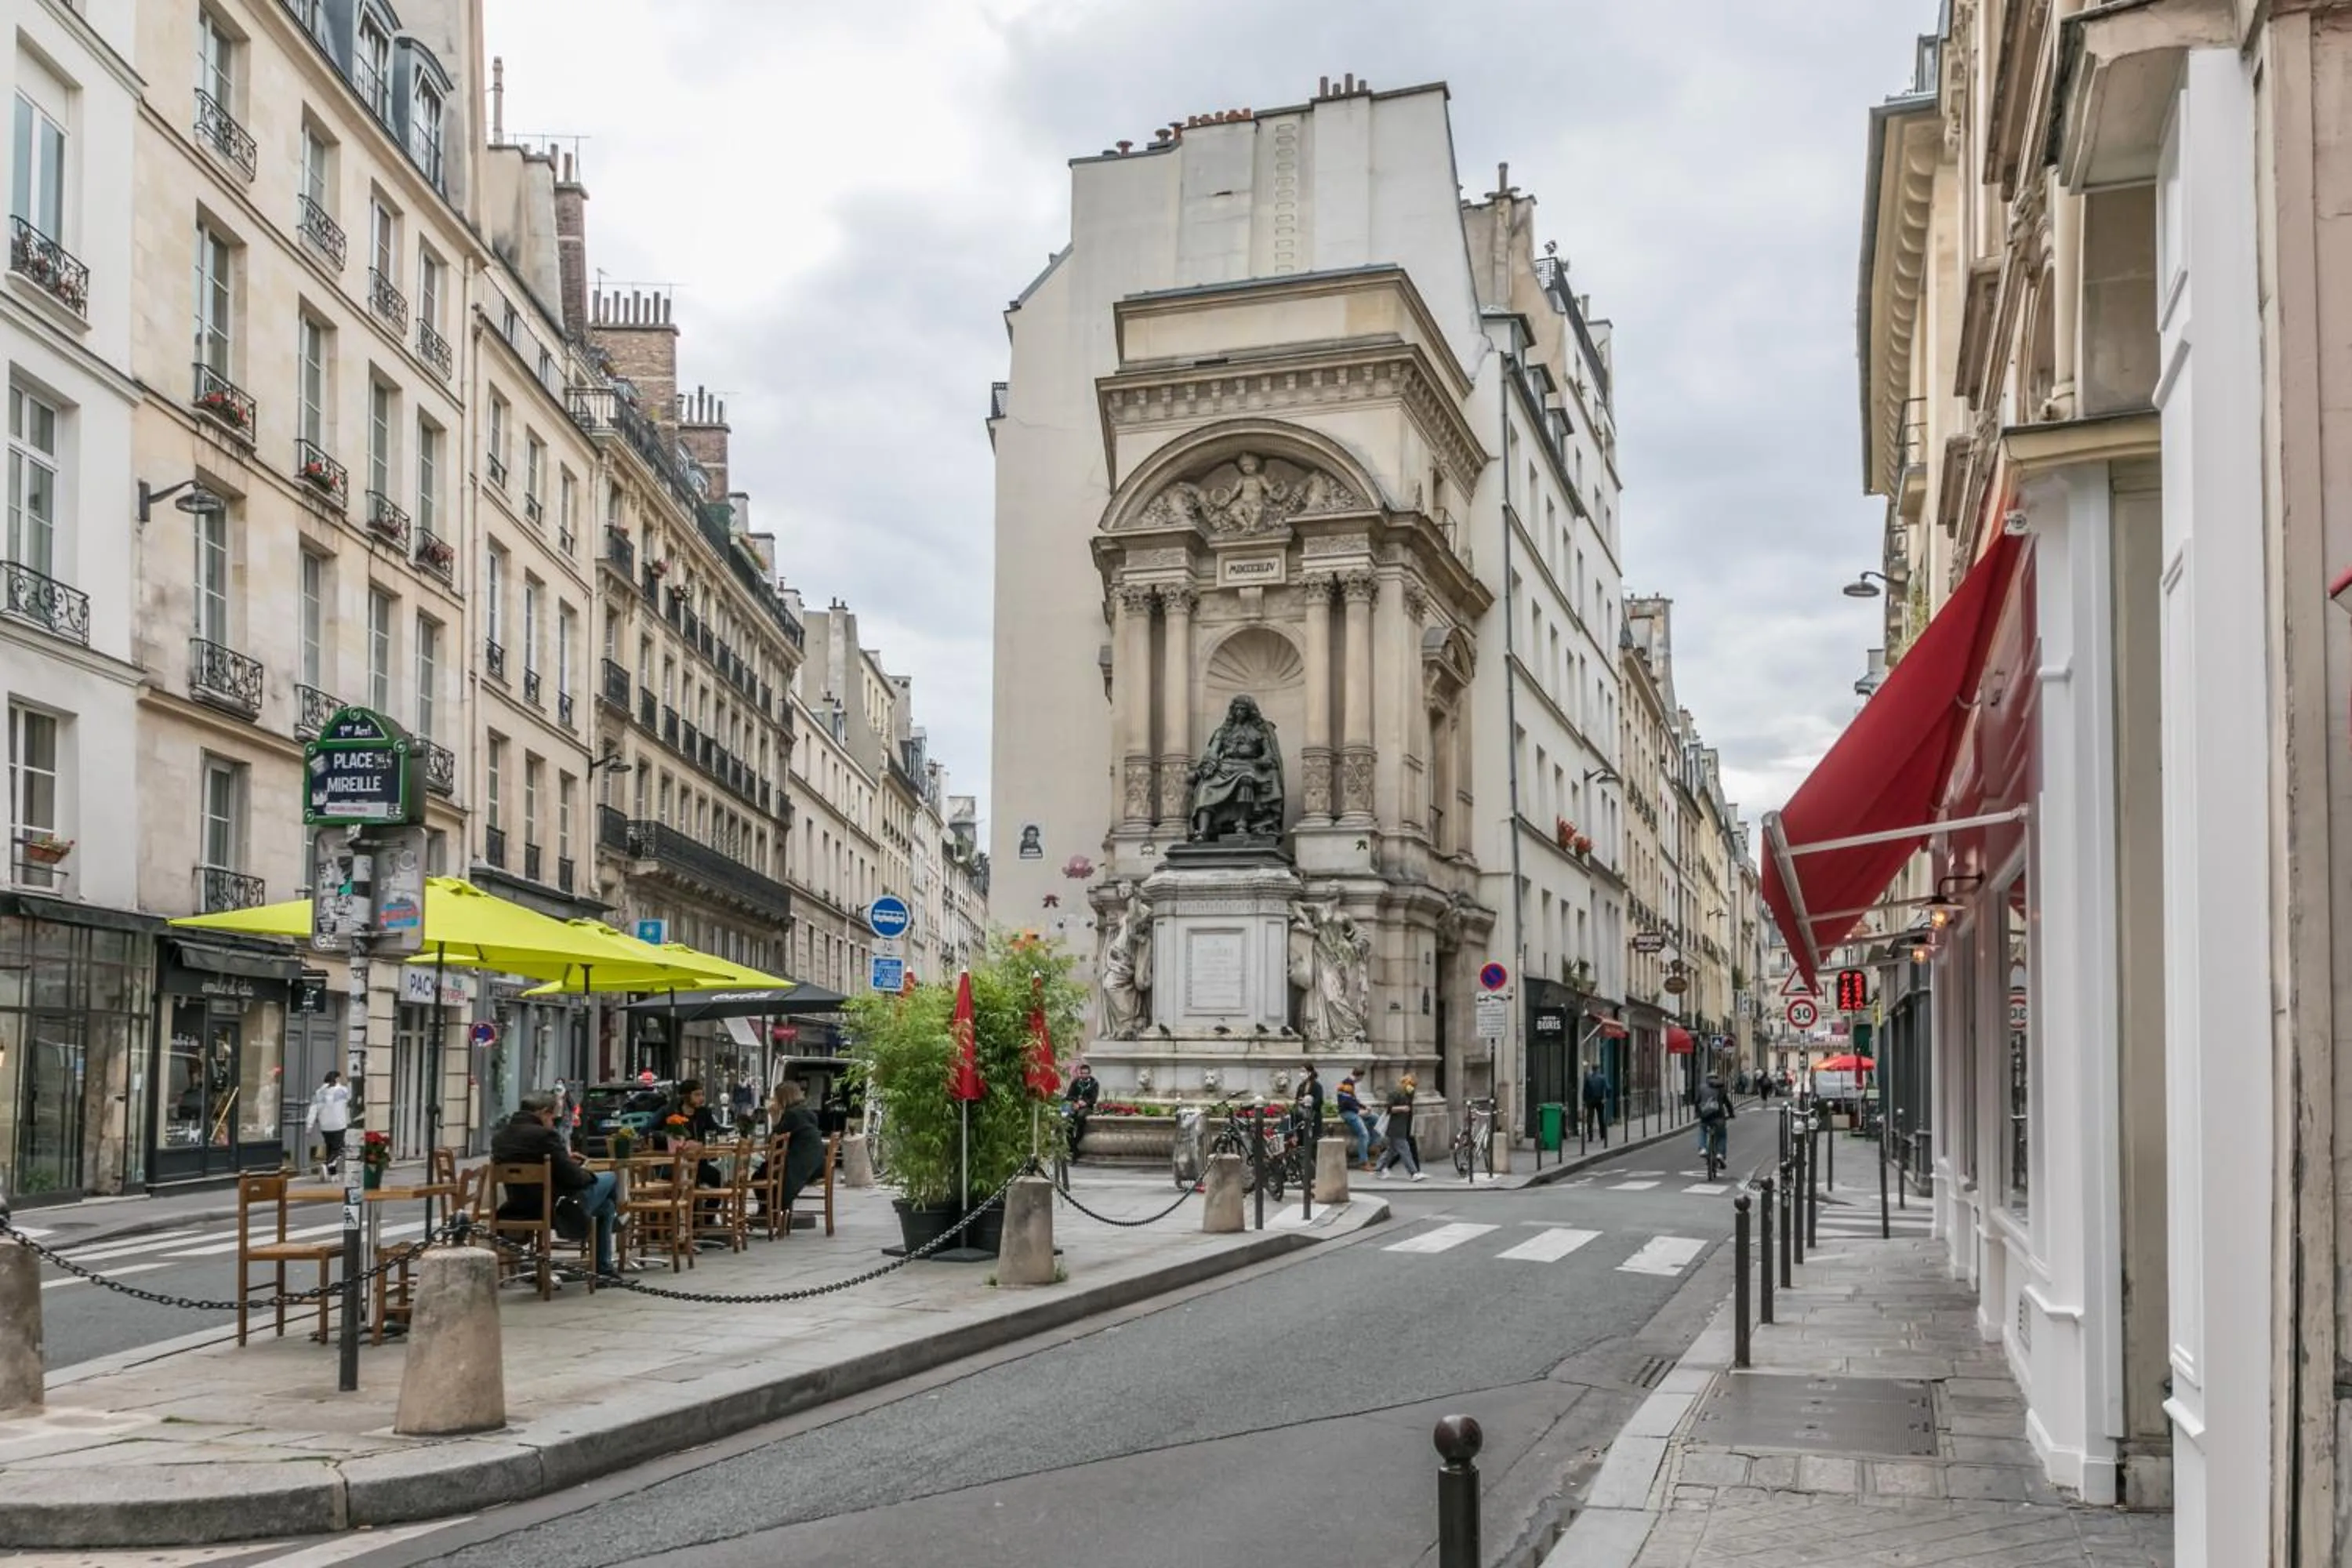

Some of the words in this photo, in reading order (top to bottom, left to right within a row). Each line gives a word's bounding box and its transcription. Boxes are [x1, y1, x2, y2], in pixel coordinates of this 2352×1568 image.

[333, 753, 374, 769] PLACE
[327, 775, 382, 793] MIREILLE
[1794, 1008, 1811, 1019] 30
